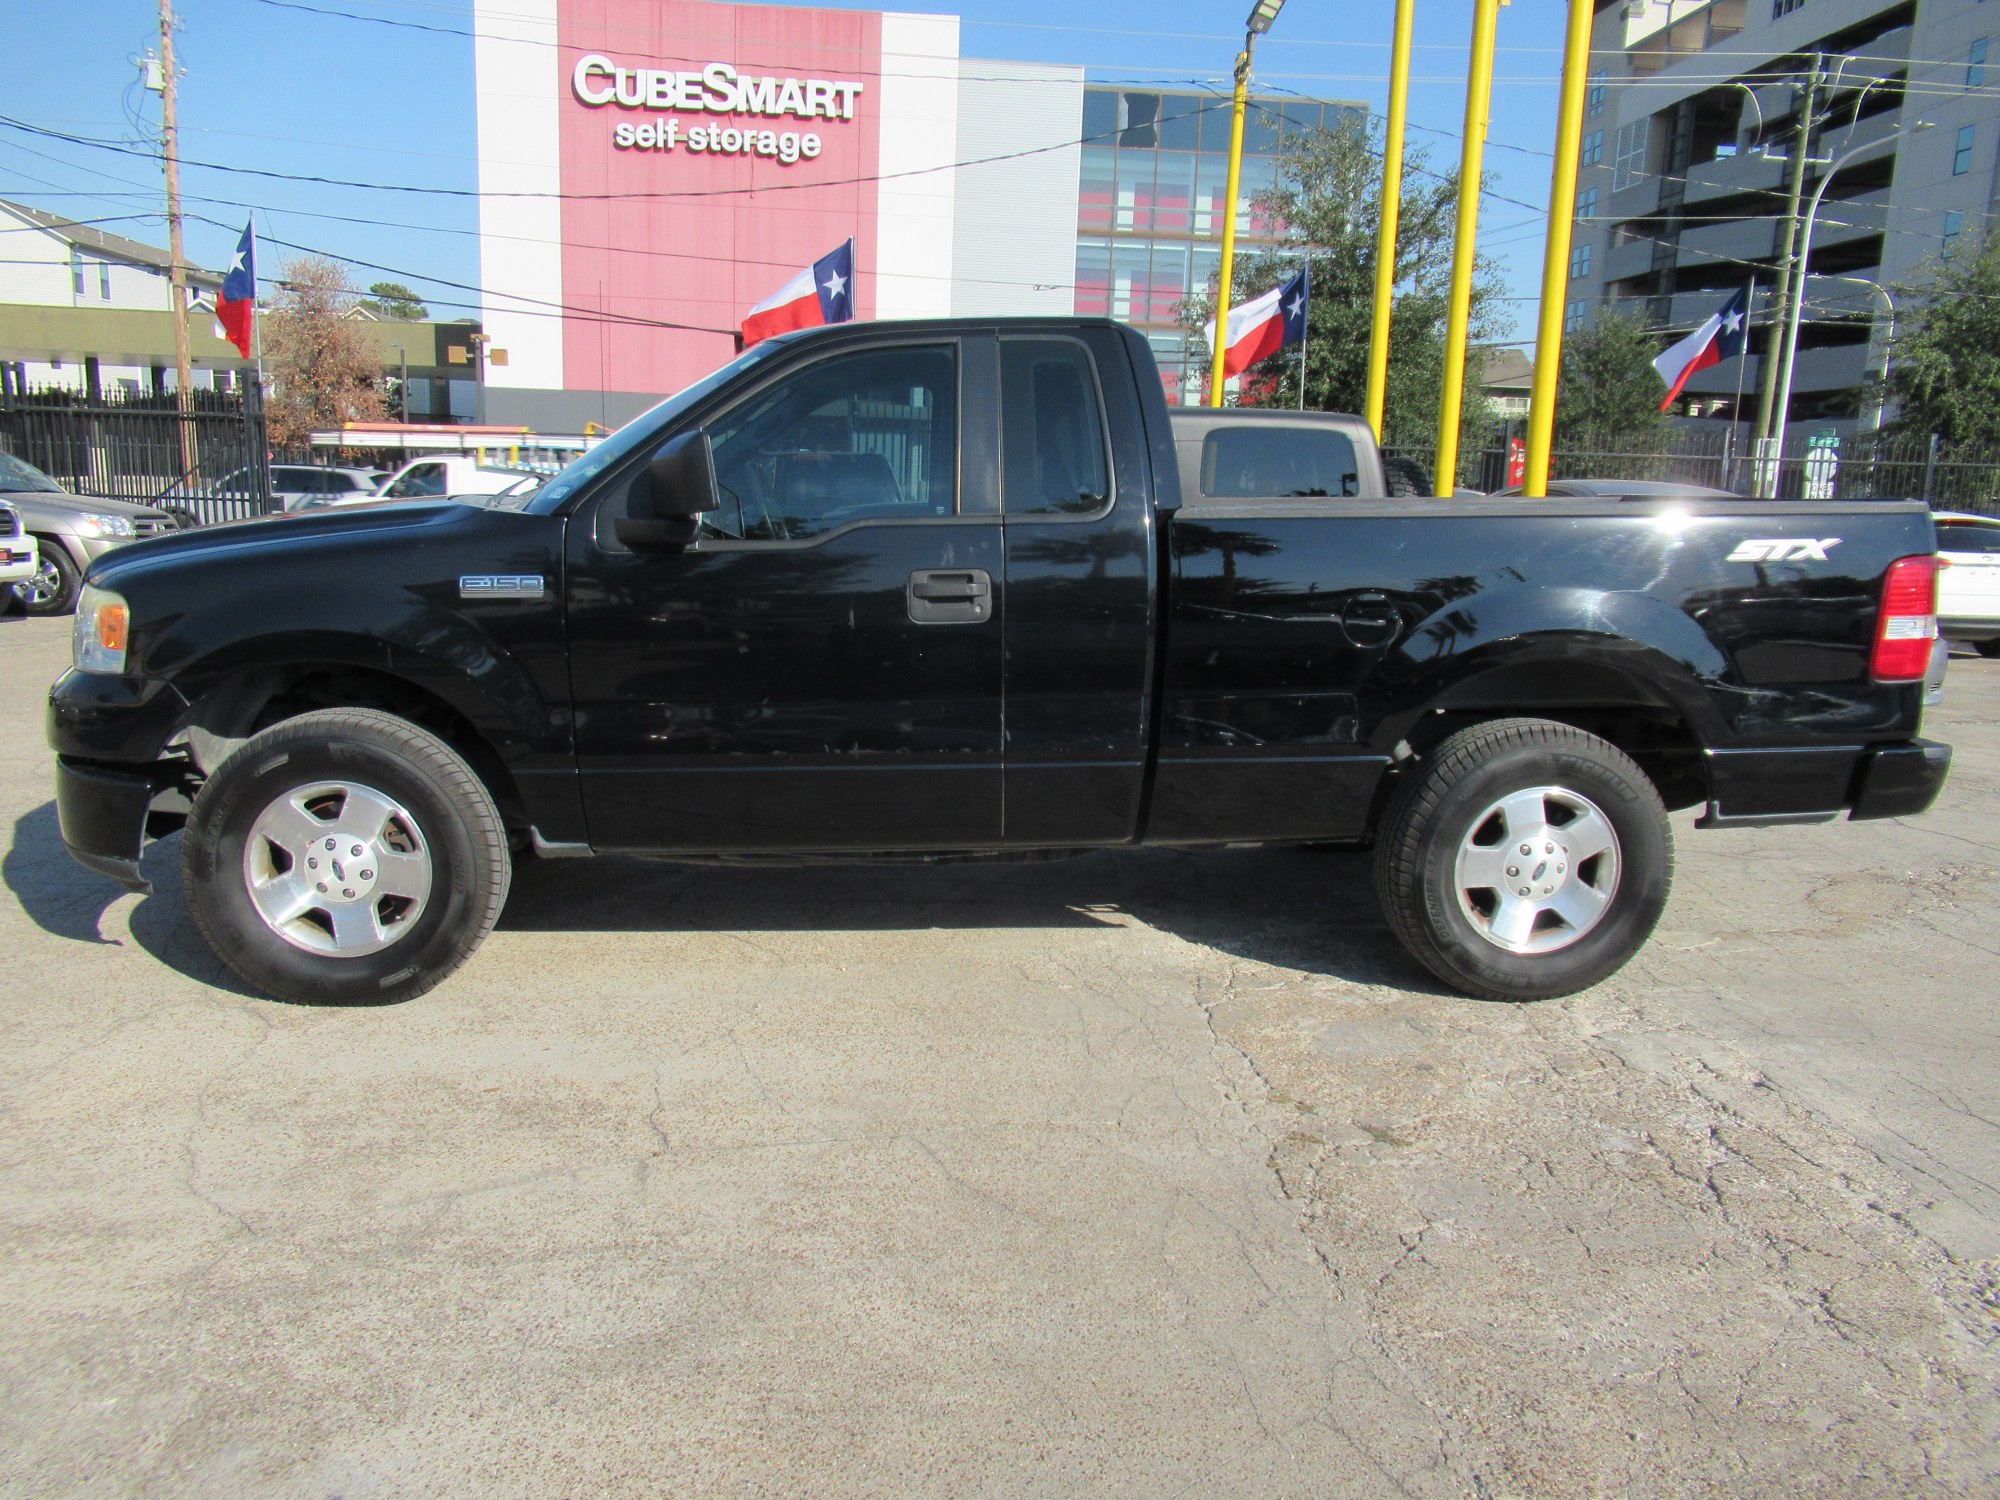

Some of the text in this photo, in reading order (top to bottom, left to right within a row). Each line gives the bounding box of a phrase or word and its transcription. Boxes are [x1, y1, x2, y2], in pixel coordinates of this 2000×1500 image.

[615, 118, 822, 164] self storage
[1726, 538, 1842, 562] STX
